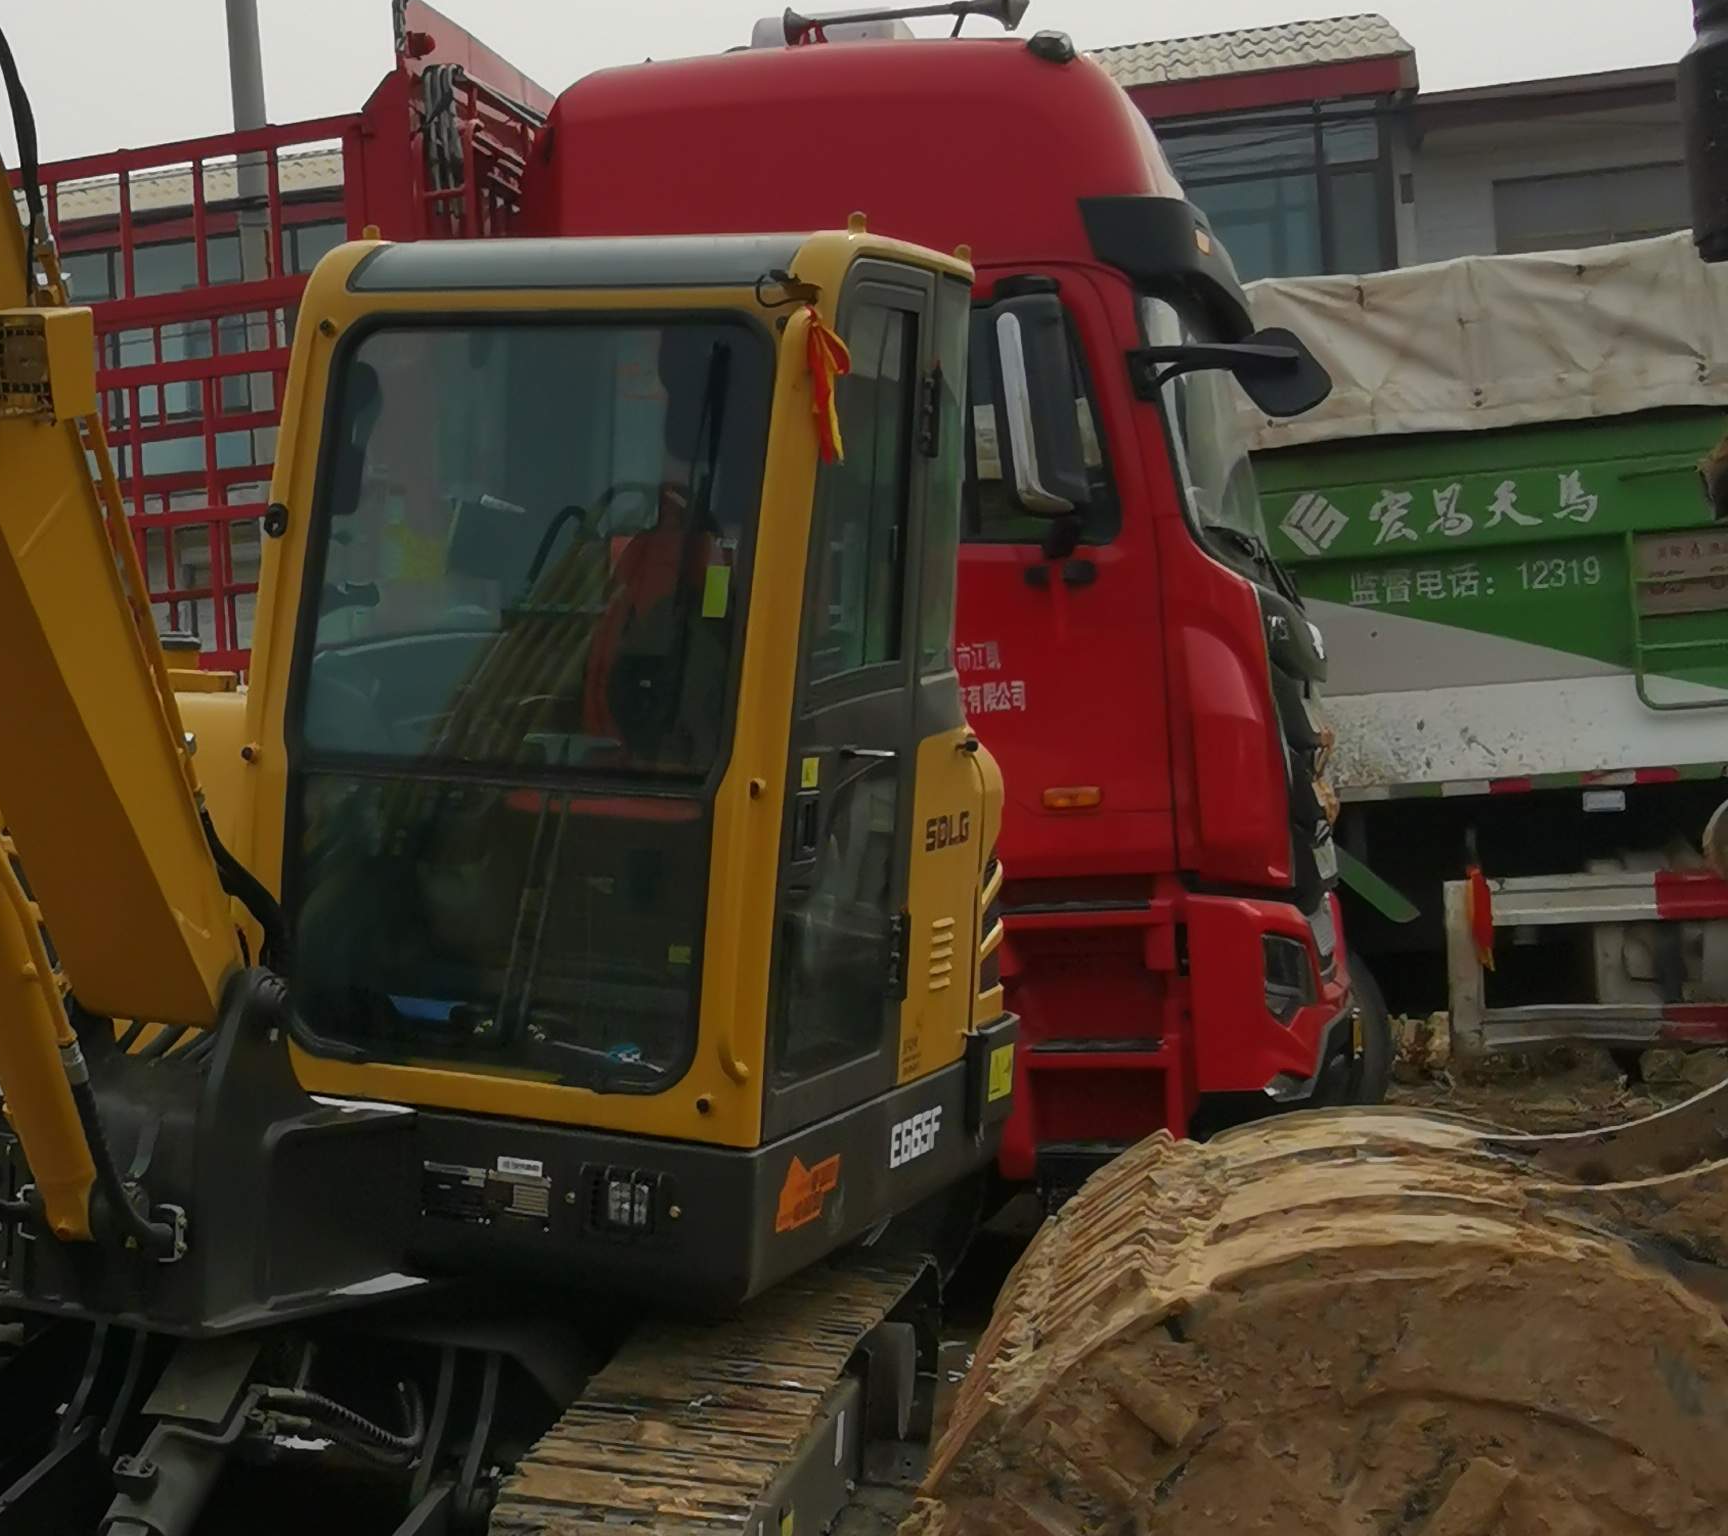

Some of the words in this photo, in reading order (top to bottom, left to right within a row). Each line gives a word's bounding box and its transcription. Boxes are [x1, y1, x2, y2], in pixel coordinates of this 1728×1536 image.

[1516, 556, 1601, 591] 12319
[925, 810, 970, 853] SDLG
[889, 1105, 943, 1169] E665F
